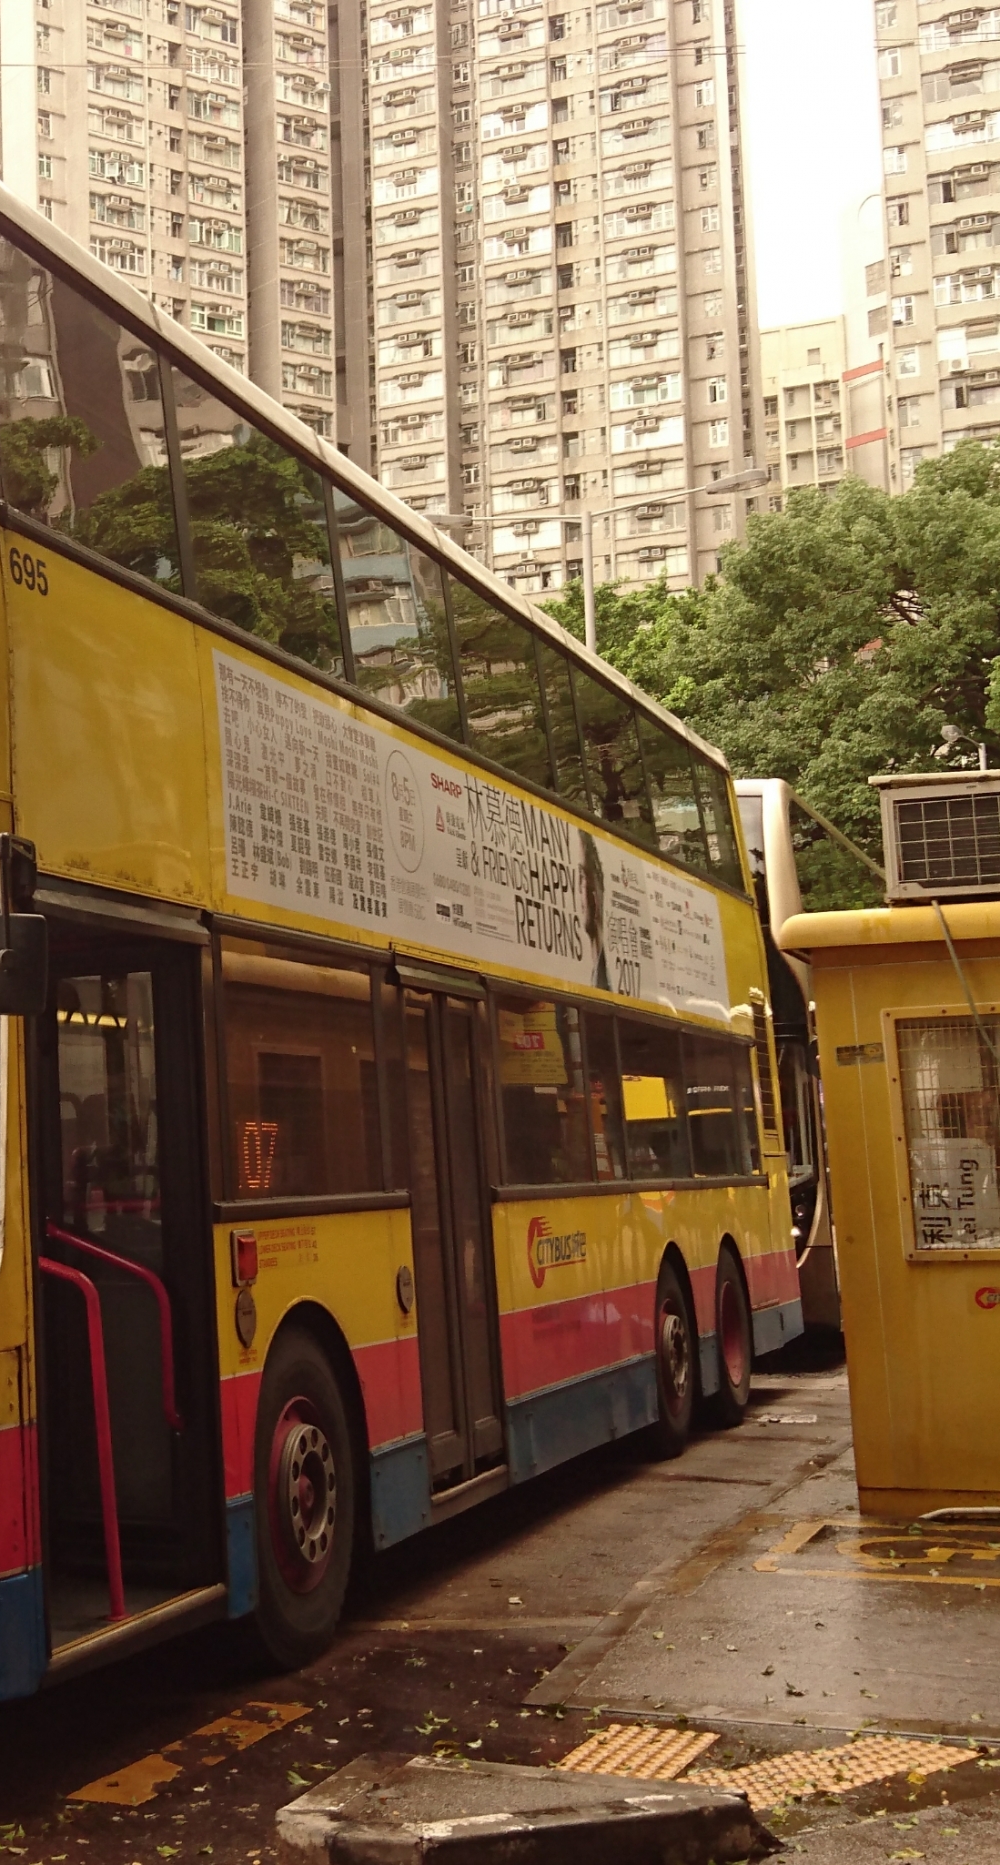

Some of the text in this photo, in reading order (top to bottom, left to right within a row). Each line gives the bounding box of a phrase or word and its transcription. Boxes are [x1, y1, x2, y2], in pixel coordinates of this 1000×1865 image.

[9, 547, 49, 597] 695
[227, 792, 252, 816] J.Arie
[430, 771, 462, 801] SHARP
[462, 771, 525, 858] 林慕德
[520, 799, 573, 865] MANY
[468, 839, 529, 894] & FRIENDS
[526, 849, 579, 912] HAPPY
[512, 894, 583, 962] RETURNS
[615, 956, 641, 999] 2017
[236, 1121, 279, 1189] 07
[957, 1159, 979, 1211] Tung
[536, 1234, 571, 1266] CITYBUS
